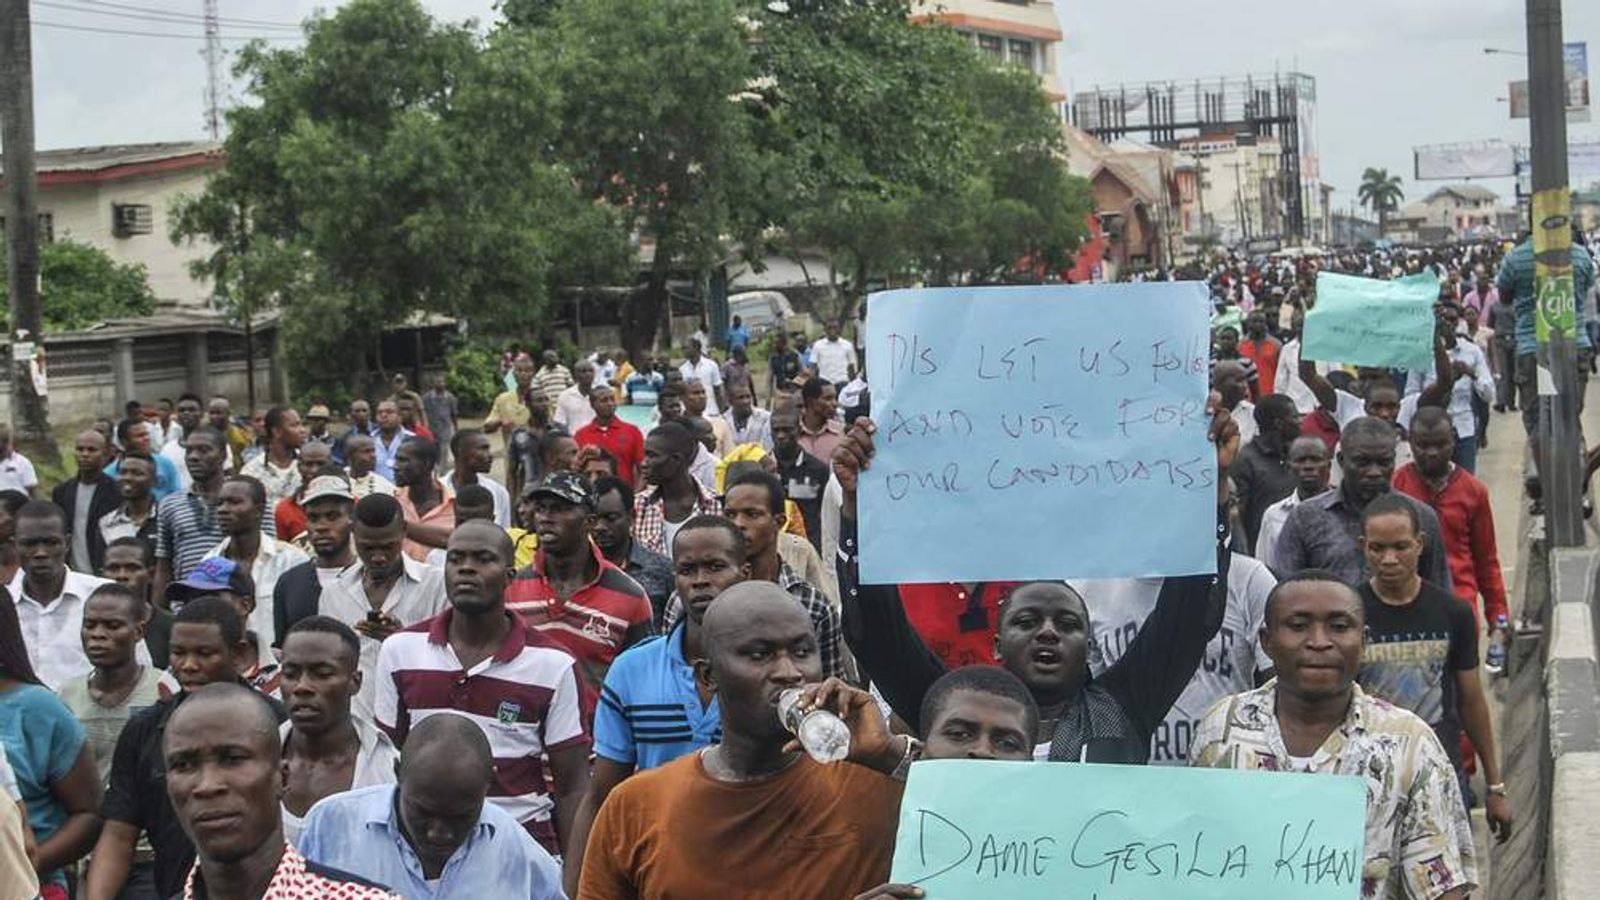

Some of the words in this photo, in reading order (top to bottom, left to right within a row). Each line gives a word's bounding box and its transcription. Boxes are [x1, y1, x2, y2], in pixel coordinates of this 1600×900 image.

[1116, 396, 1208, 438] FOR
[911, 808, 1056, 885] DAME
[1071, 809, 1250, 884] GESILA
[1273, 819, 1357, 886] KHAN
